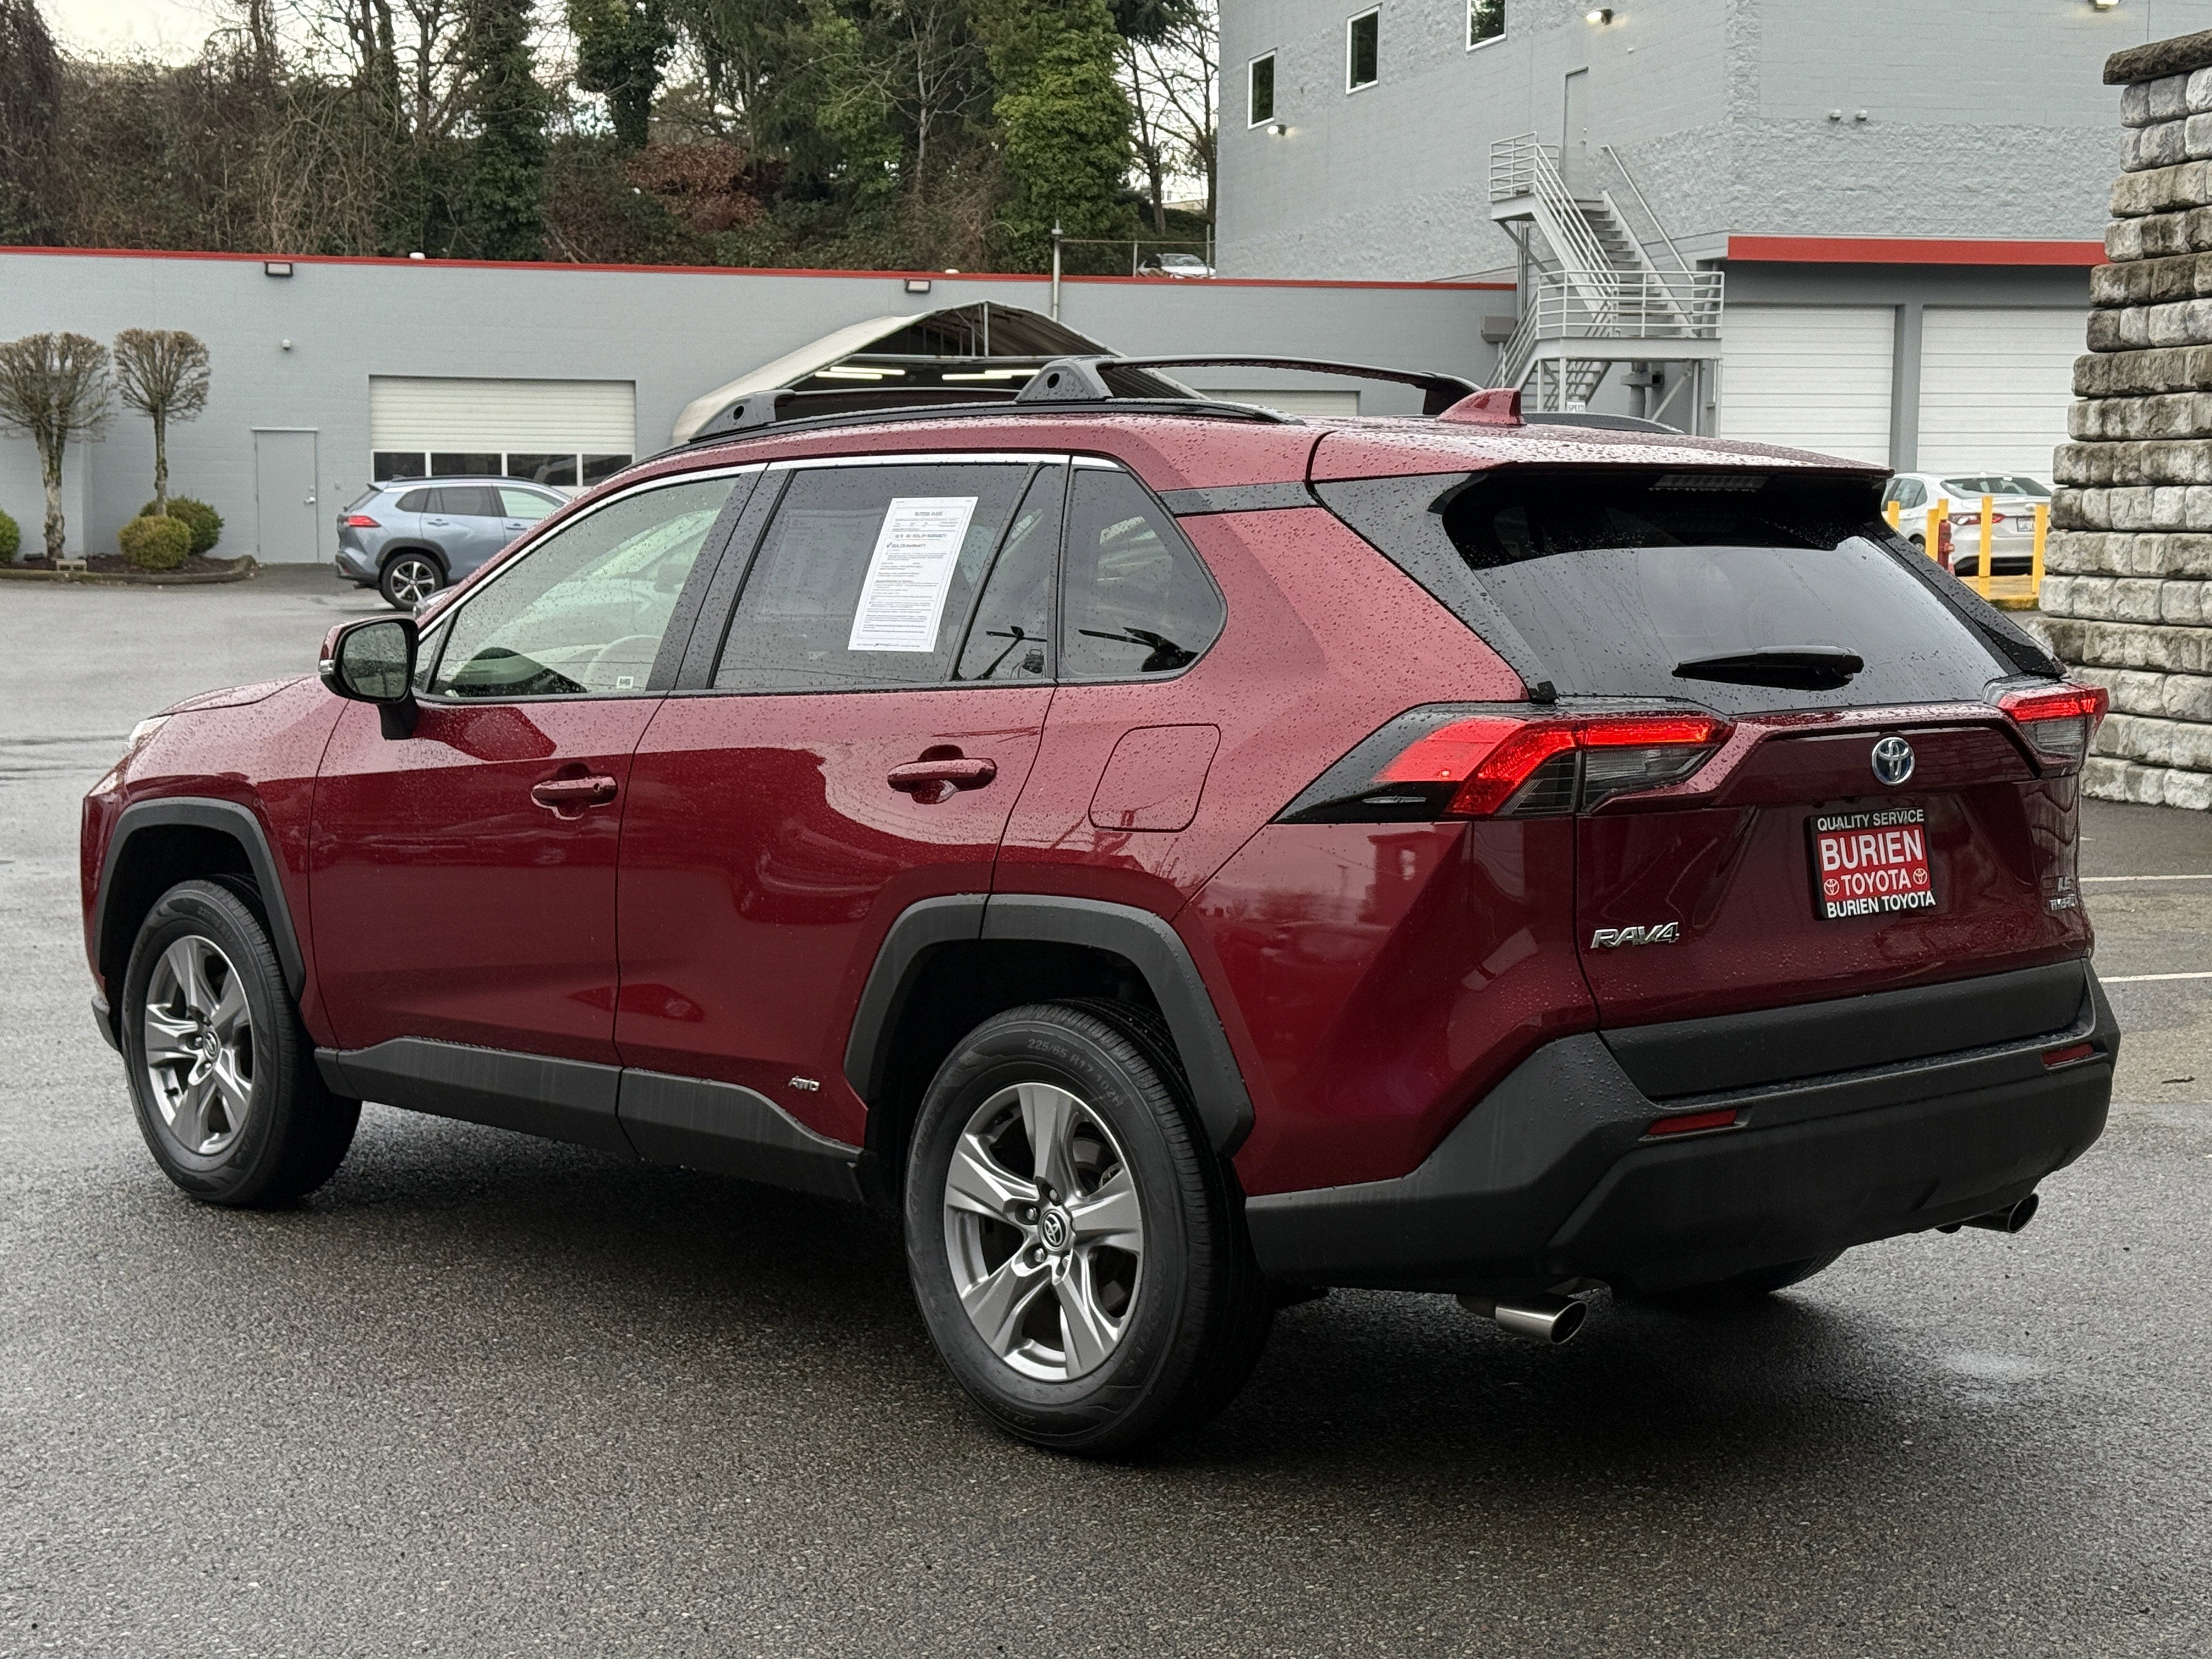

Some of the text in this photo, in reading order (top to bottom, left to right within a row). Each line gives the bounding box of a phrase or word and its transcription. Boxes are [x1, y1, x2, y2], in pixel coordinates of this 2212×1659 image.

[1818, 809, 1925, 831] QUALITY SERVICE
[1820, 830, 1923, 871] BURIEN
[1841, 868, 1912, 896] TOYOTA
[1827, 890, 1936, 918] BURIEN TOYOTA
[1590, 922, 1680, 949] RAV4
[788, 1075, 820, 1092] AWD
[1027, 1039, 1126, 1109] 225/65 R17 102H
